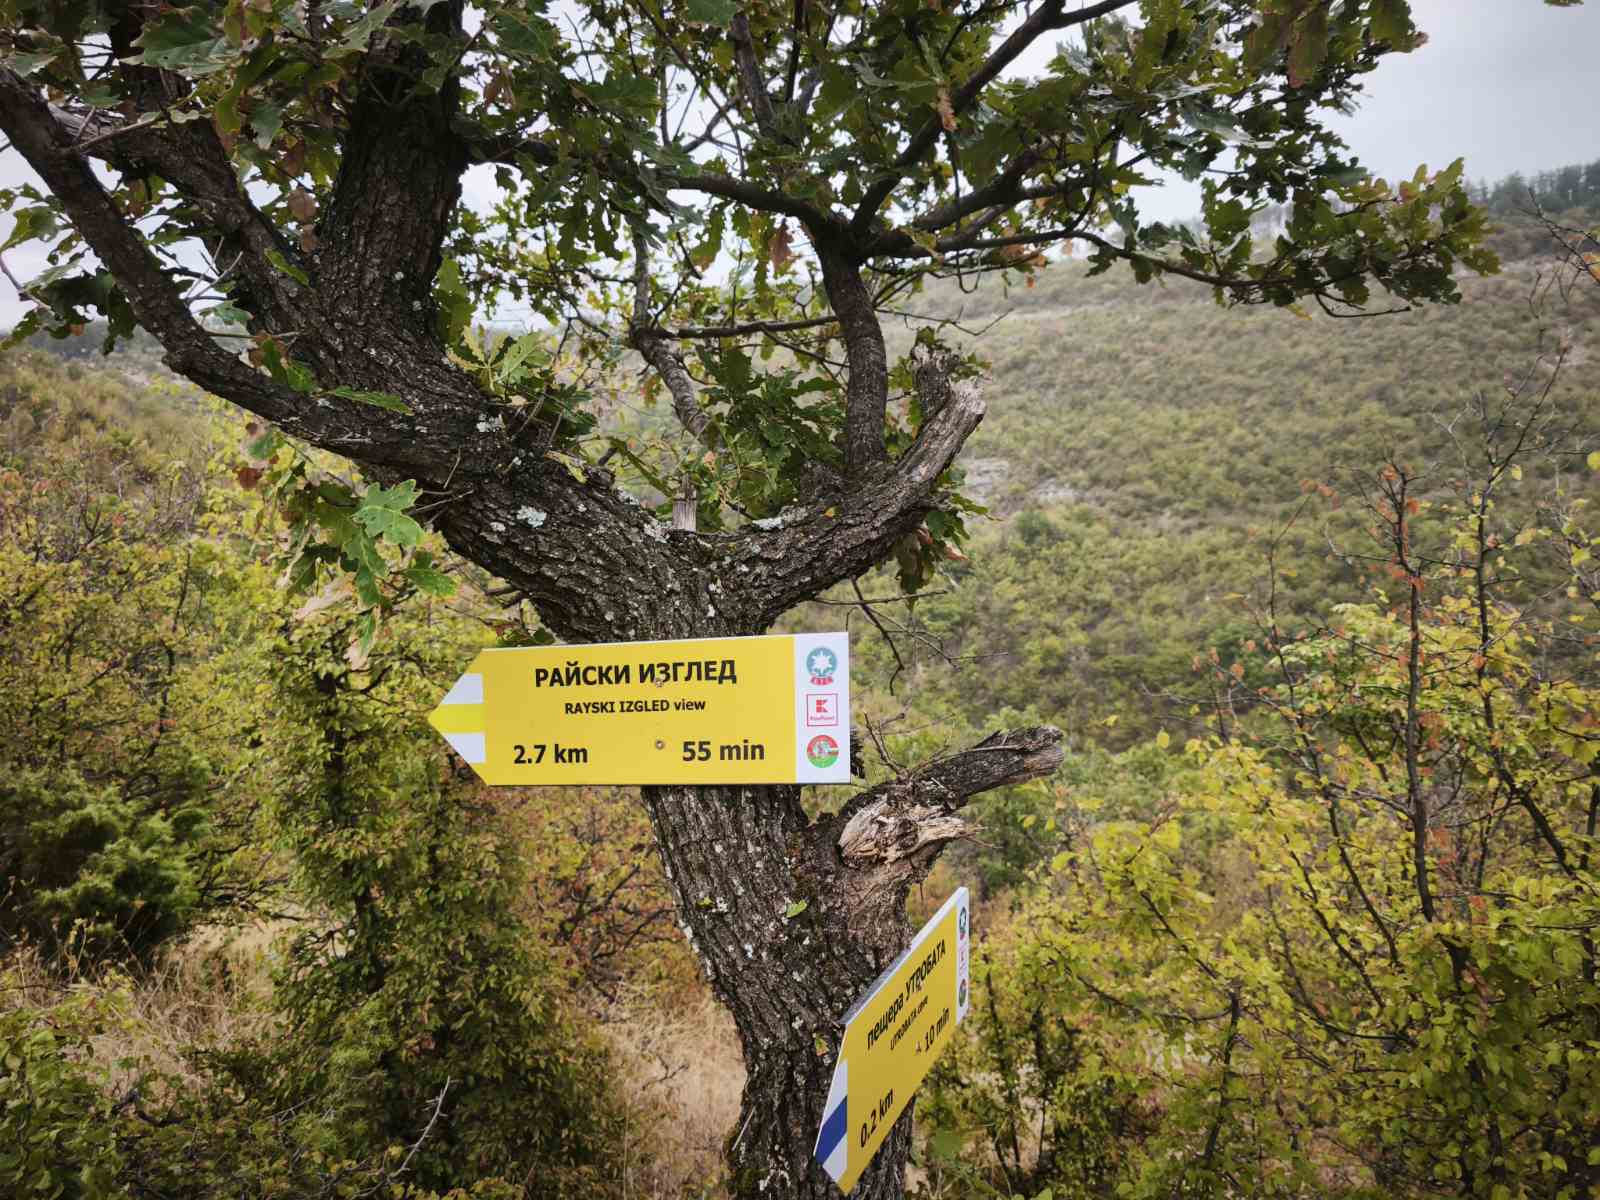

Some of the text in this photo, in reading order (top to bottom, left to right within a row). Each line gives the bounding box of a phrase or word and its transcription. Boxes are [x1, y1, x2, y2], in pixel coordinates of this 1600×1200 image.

[535, 659, 737, 687] РАЙСКИ ИЗГЛЕД
[564, 698, 706, 715] RAYSKI IZGLED view
[513, 744, 588, 764] 2.7 km
[682, 740, 765, 762] 55 min
[867, 939, 946, 1051] пещера УТРОБАТА
[925, 1007, 950, 1053] 10 min
[860, 1087, 894, 1148] 0.2 km
